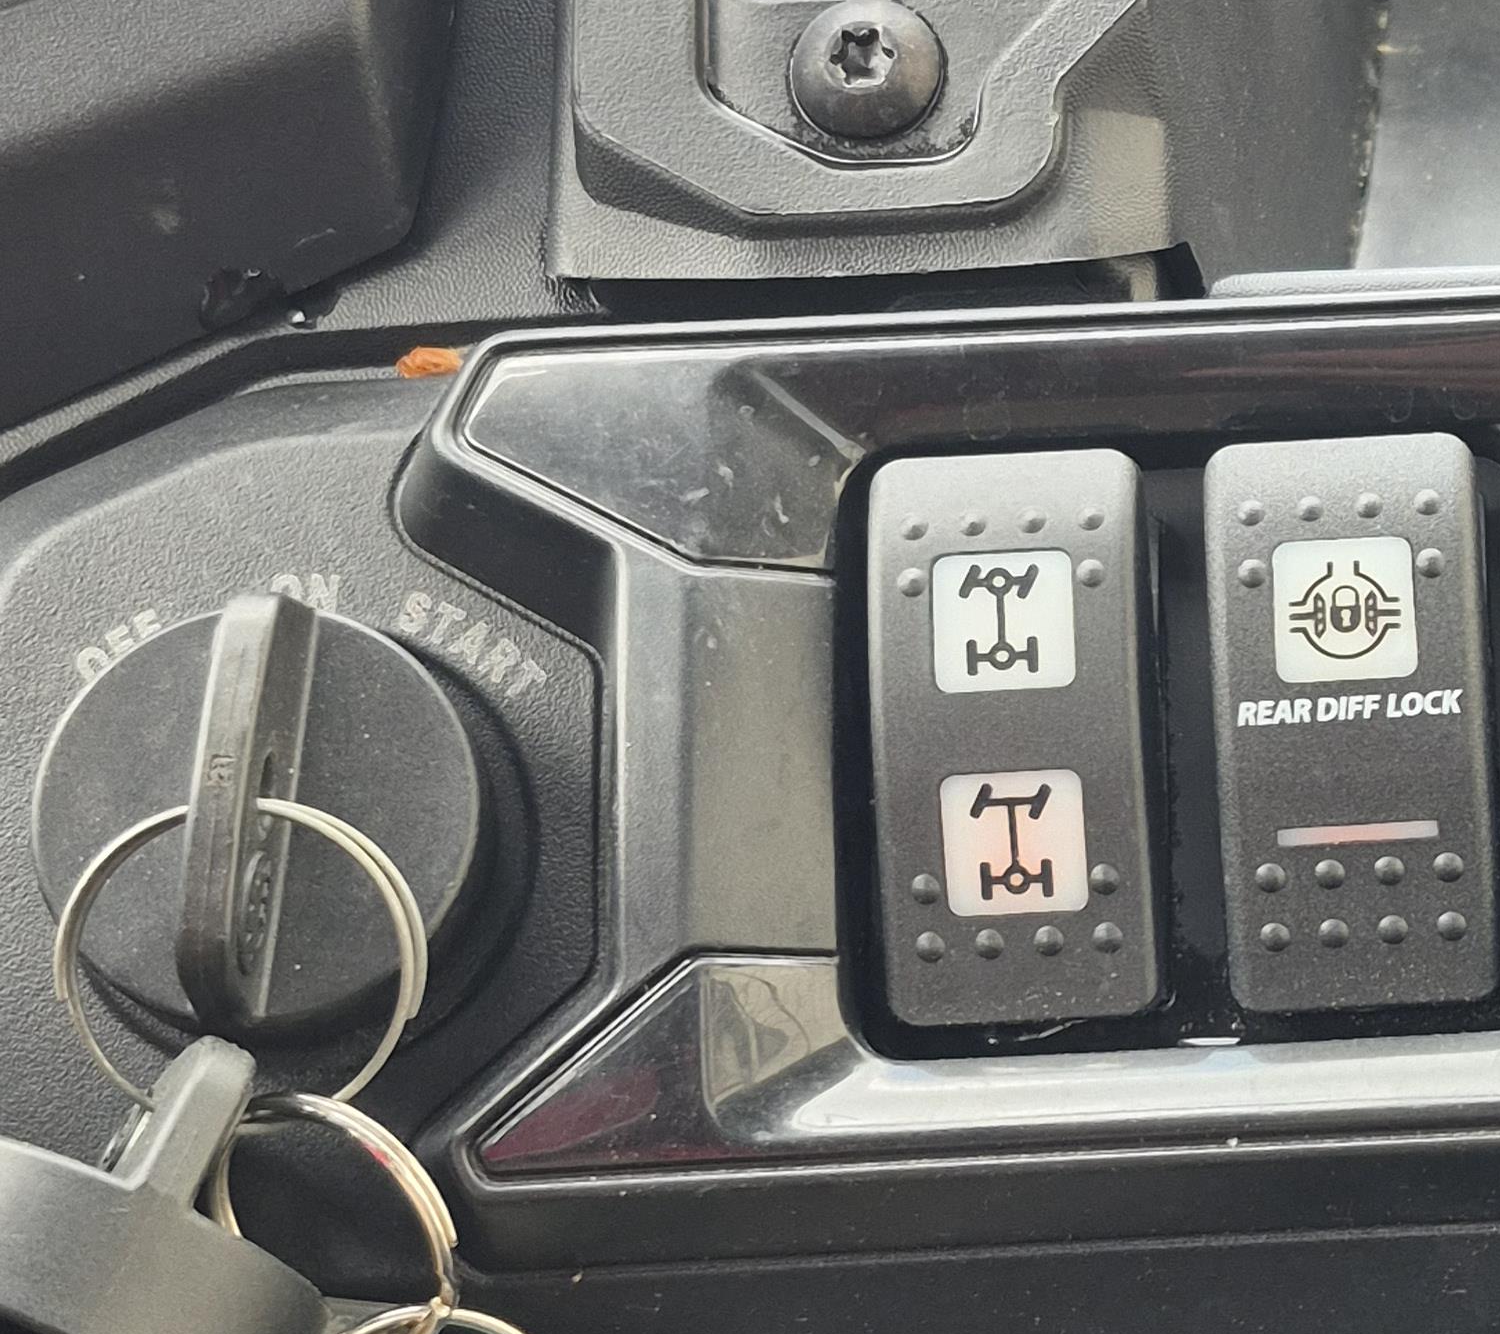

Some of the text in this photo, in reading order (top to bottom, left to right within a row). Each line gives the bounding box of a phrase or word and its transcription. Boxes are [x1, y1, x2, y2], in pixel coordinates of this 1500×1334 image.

[271, 573, 341, 612] ON
[77, 607, 164, 680] OFF
[398, 589, 548, 697] START
[1237, 689, 1463, 727] REAR DIFF LOCK
